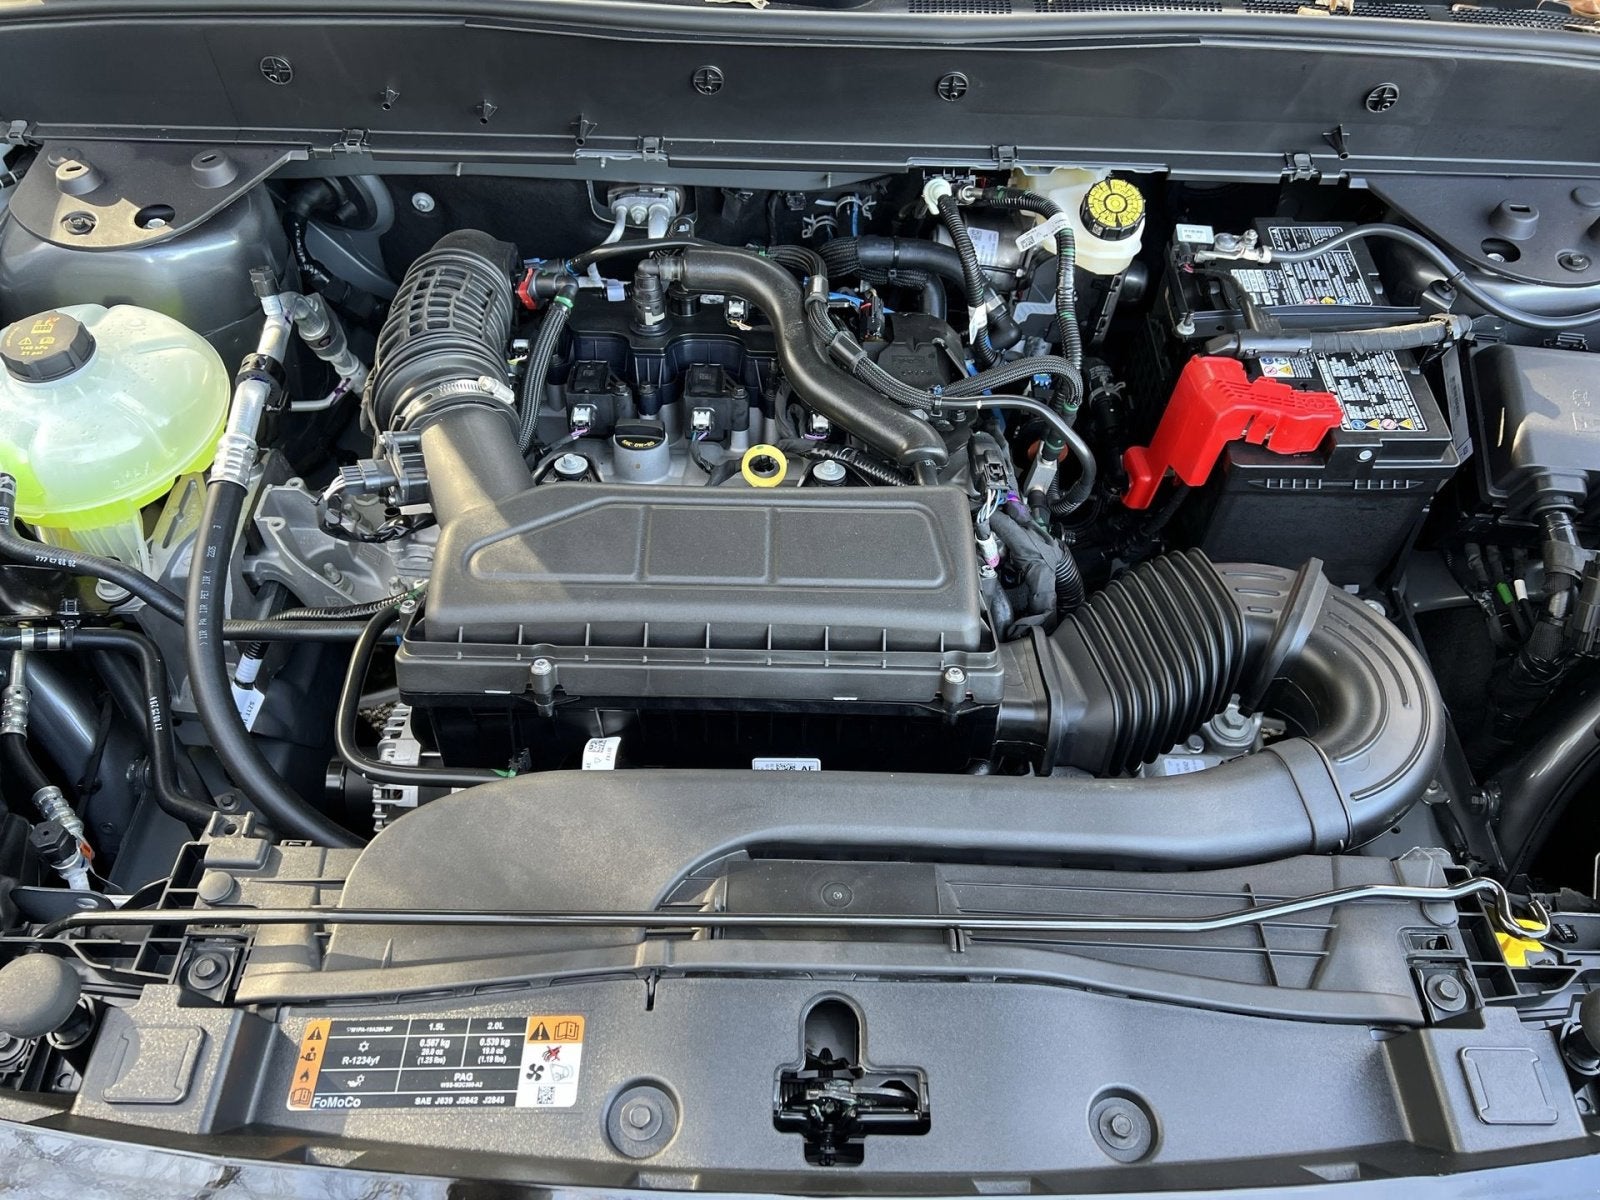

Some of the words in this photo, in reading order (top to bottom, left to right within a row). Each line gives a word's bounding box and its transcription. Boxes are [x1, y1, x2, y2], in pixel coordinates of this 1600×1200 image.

[200, 590, 209, 600] PET
[429, 1022, 445, 1031] 1.5L
[487, 1022, 504, 1030] 2.0L
[440, 1038, 451, 1049] kg
[500, 1037, 511, 1048] kg
[341, 1055, 381, 1066] R-1234yf
[454, 1072, 473, 1081] PAG
[312, 1096, 361, 1108] FoMoCo
[415, 1097, 432, 1105] SAE
